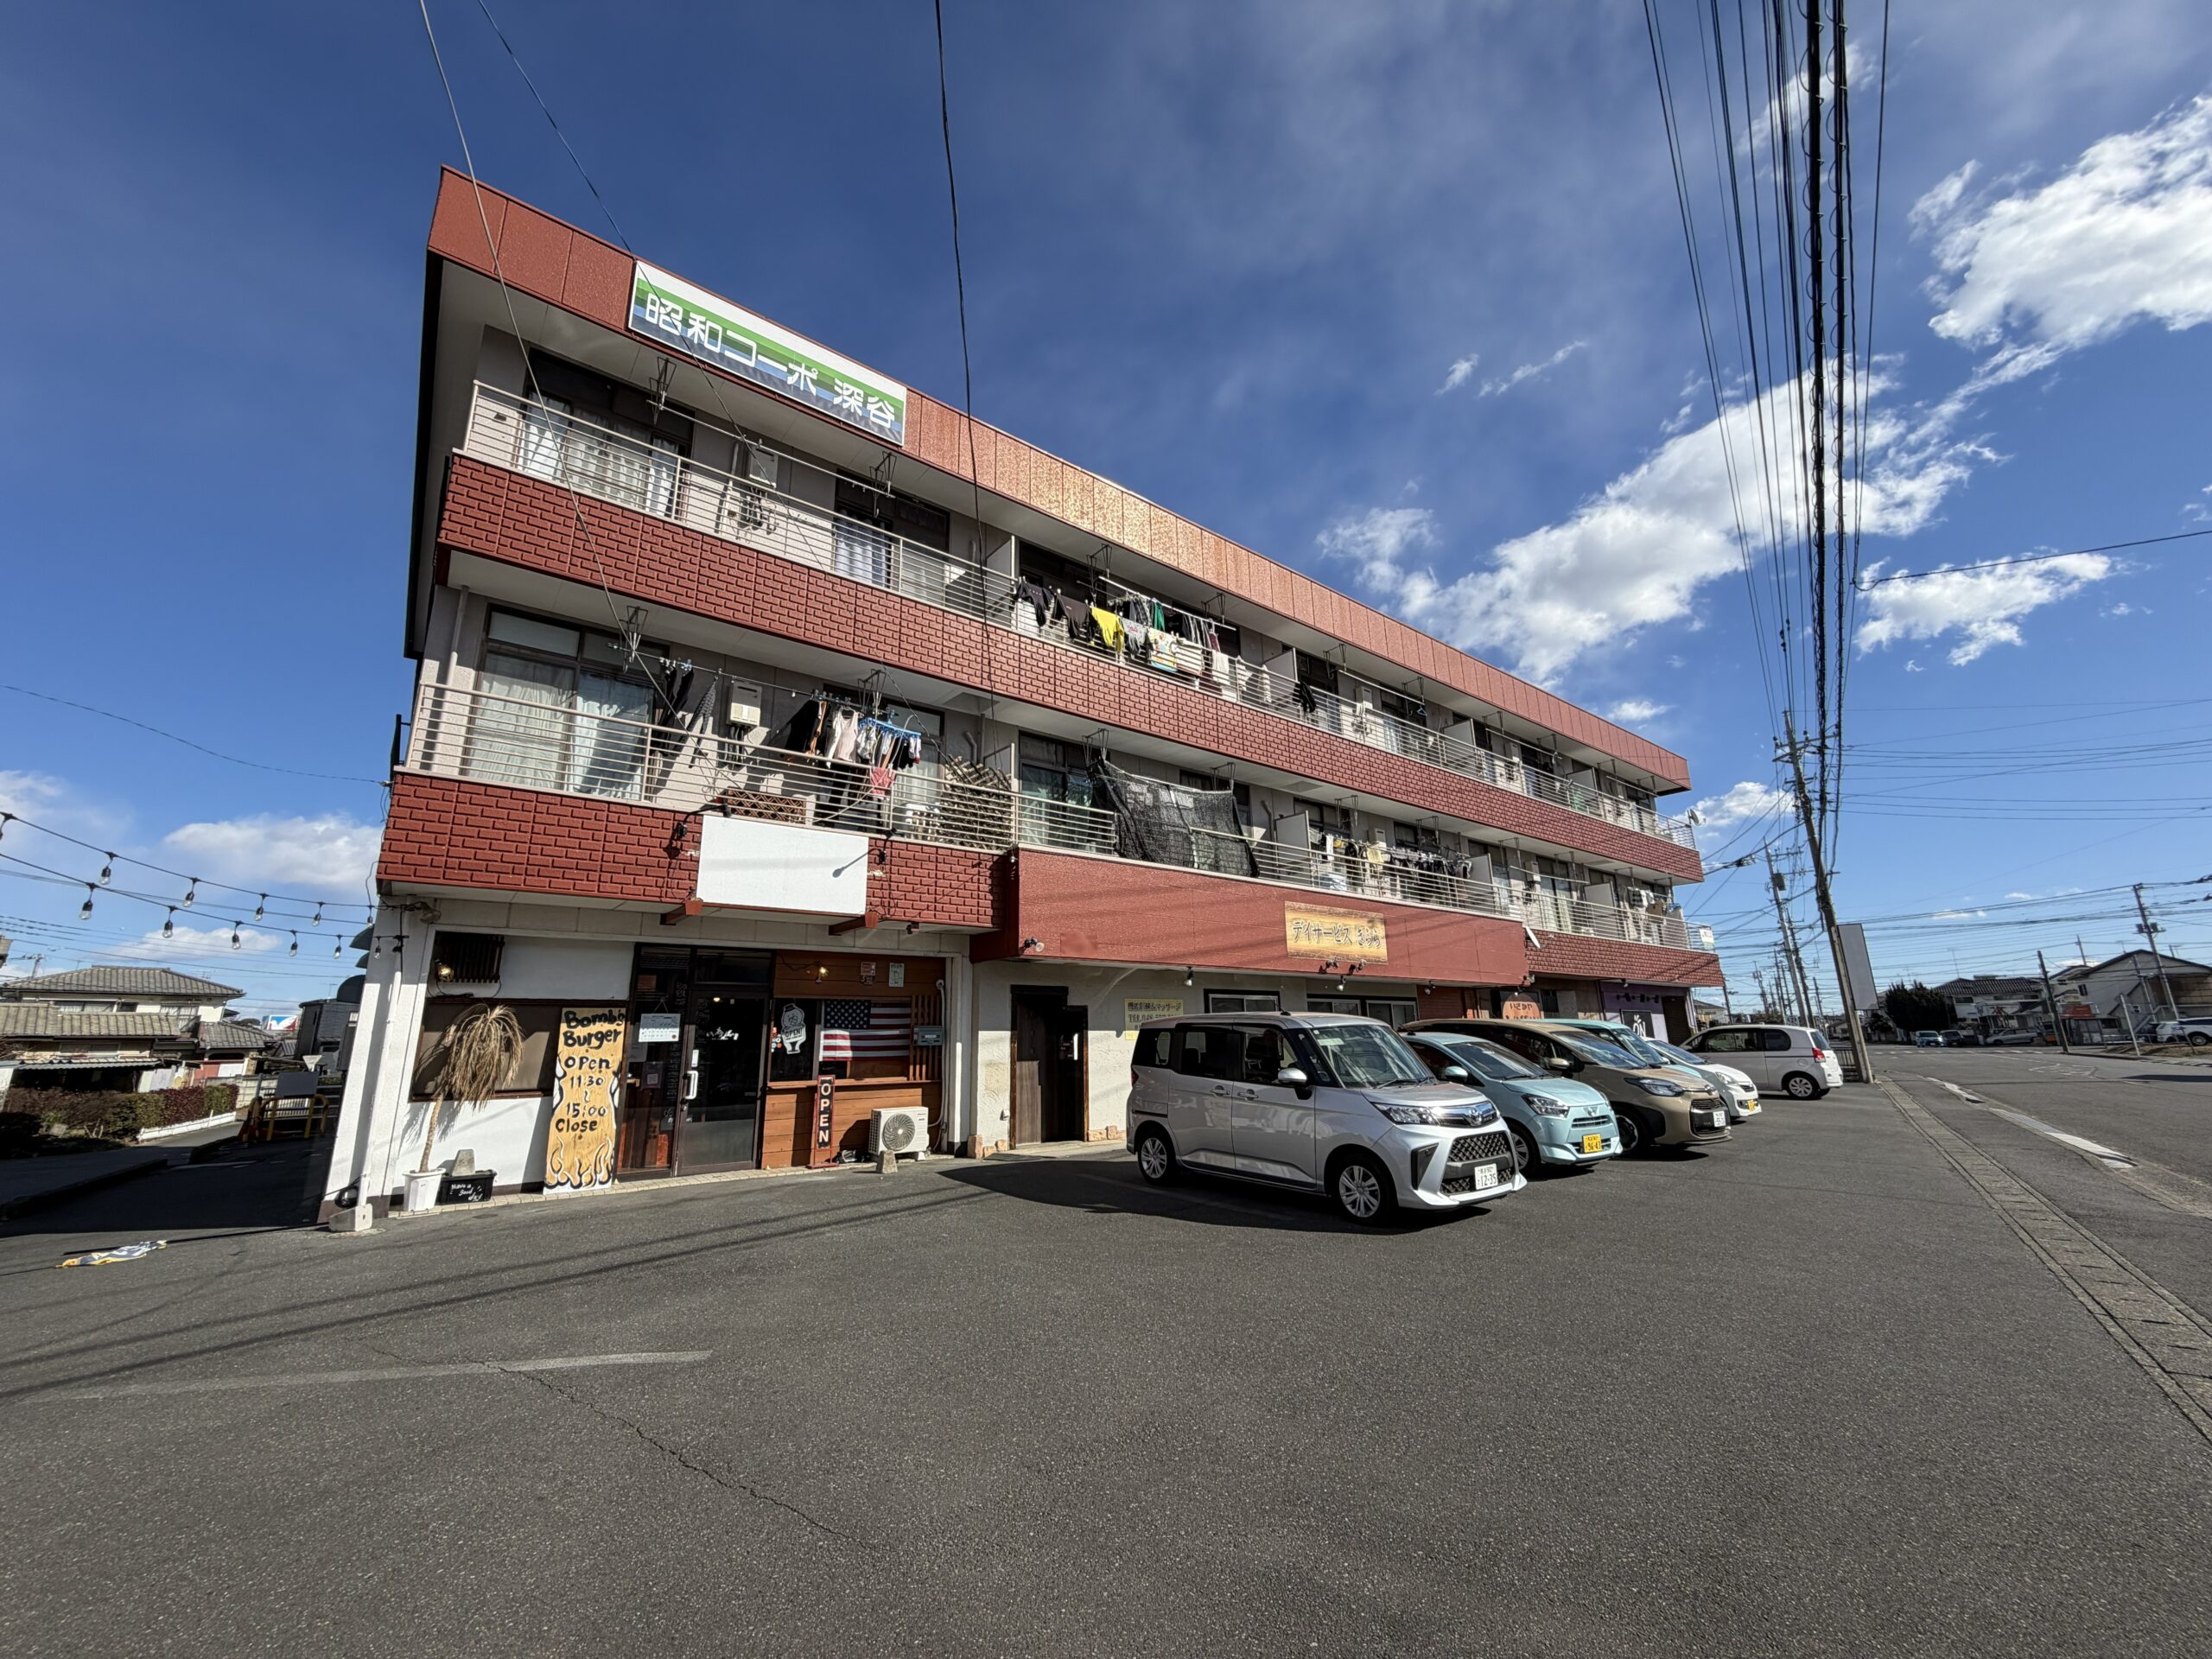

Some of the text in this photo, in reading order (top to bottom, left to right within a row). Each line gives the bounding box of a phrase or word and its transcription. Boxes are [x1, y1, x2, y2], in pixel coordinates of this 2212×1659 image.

[645, 292, 895, 429] 昭和コーポ 深谷
[1293, 920, 1381, 947] デイサービス きらら
[563, 1028, 622, 1050] Burger
[566, 1103, 607, 1118] 15:00
[818, 1083, 831, 1143] OPEN
[555, 1118, 598, 1134] Close
